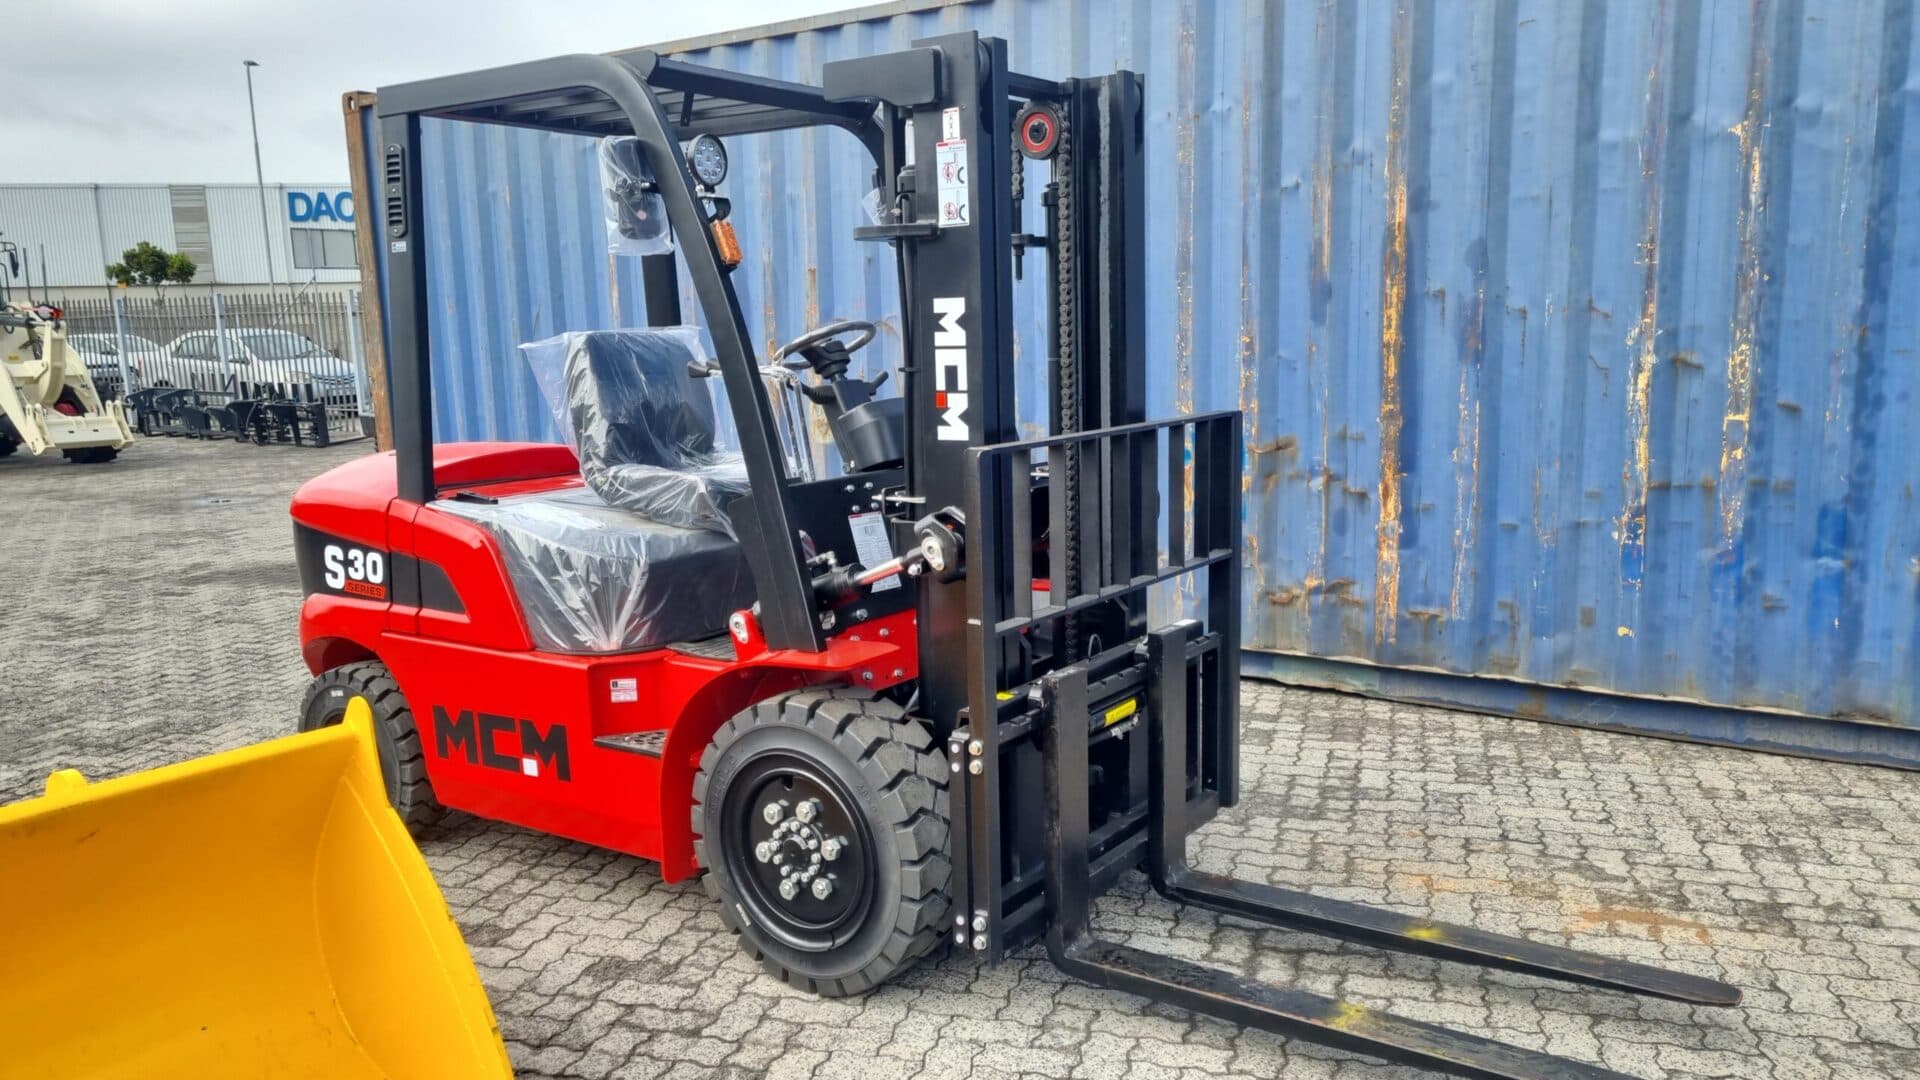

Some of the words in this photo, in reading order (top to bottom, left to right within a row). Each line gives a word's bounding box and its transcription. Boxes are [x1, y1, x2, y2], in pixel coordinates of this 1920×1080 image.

[933, 297, 969, 441] MCM
[346, 581, 384, 598] SERIES
[432, 704, 571, 783] MCM
